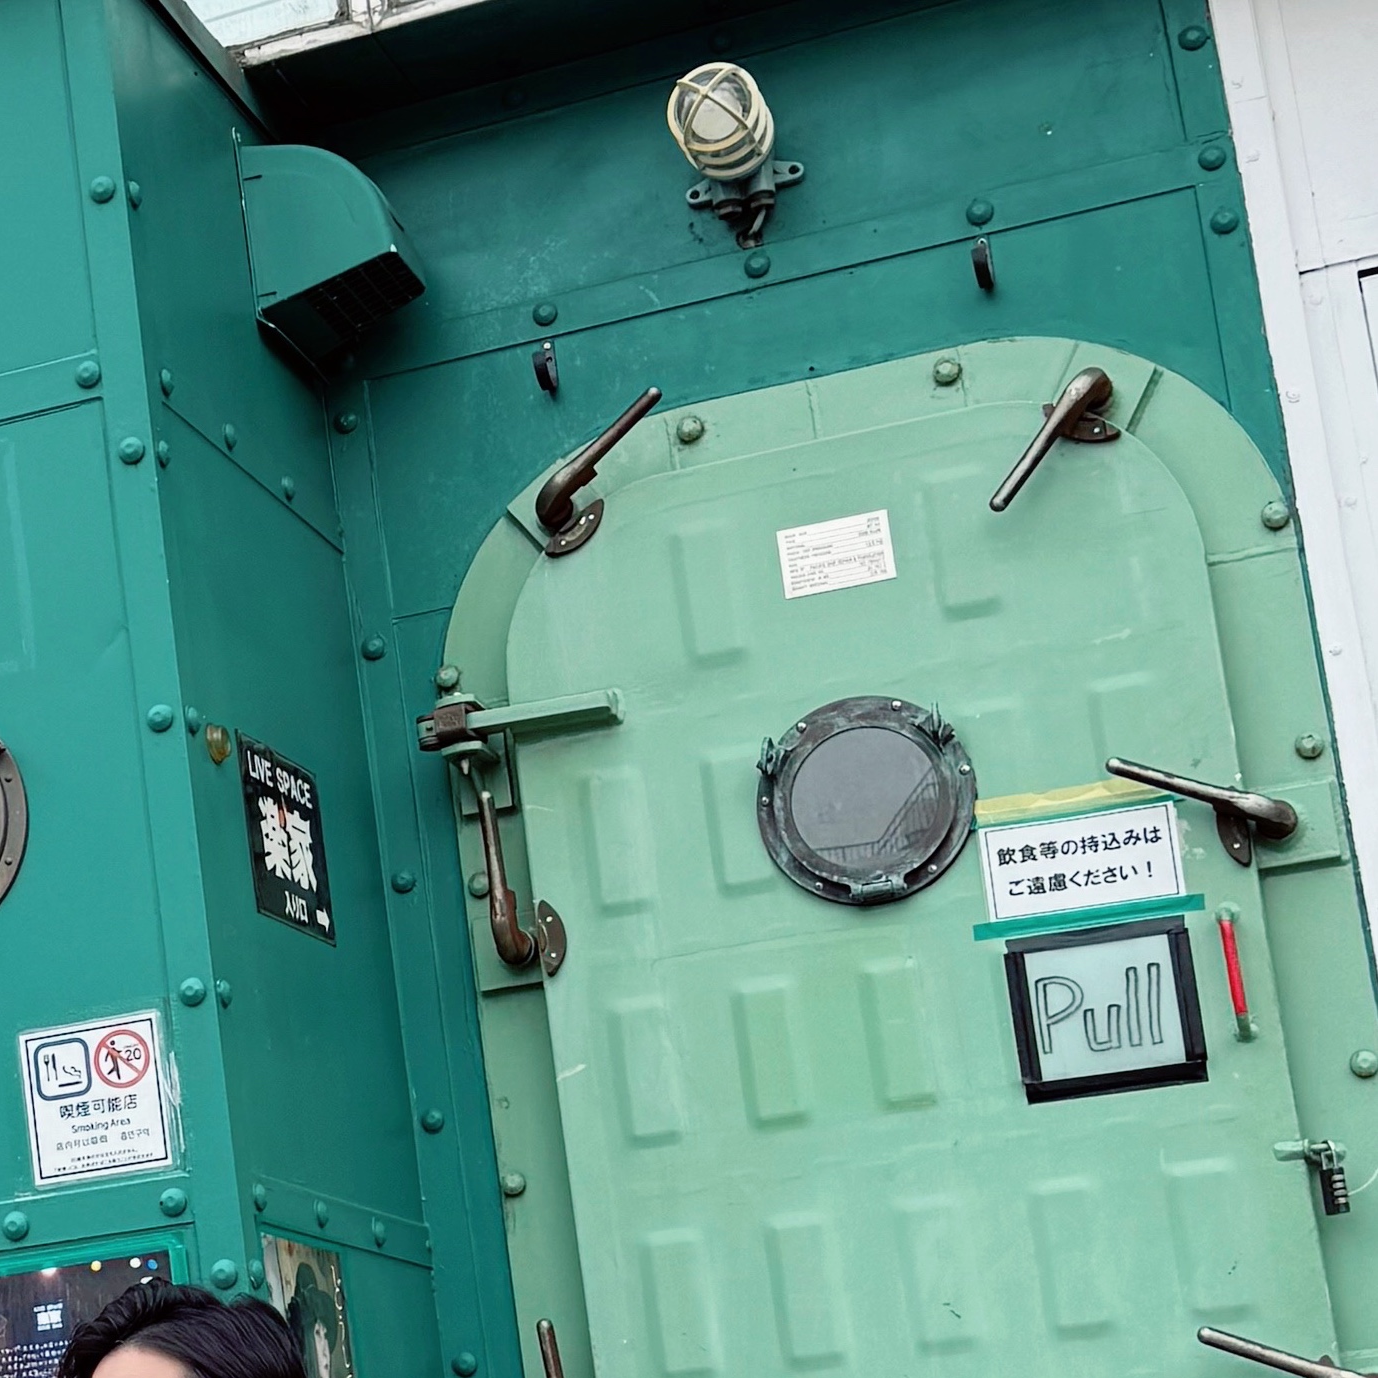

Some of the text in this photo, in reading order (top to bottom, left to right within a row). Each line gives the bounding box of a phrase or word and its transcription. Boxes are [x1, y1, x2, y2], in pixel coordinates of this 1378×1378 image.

[247, 750, 313, 809] LIVE SPACE
[258, 796, 317, 893] 楽家
[997, 826, 1162, 867] 飲食等の持込みは
[1035, 962, 1163, 1055] Pull
[125, 1047, 142, 1062] 20
[59, 1093, 138, 1120] 喫煙可能店
[71, 1117, 131, 1134] Smoking Area
